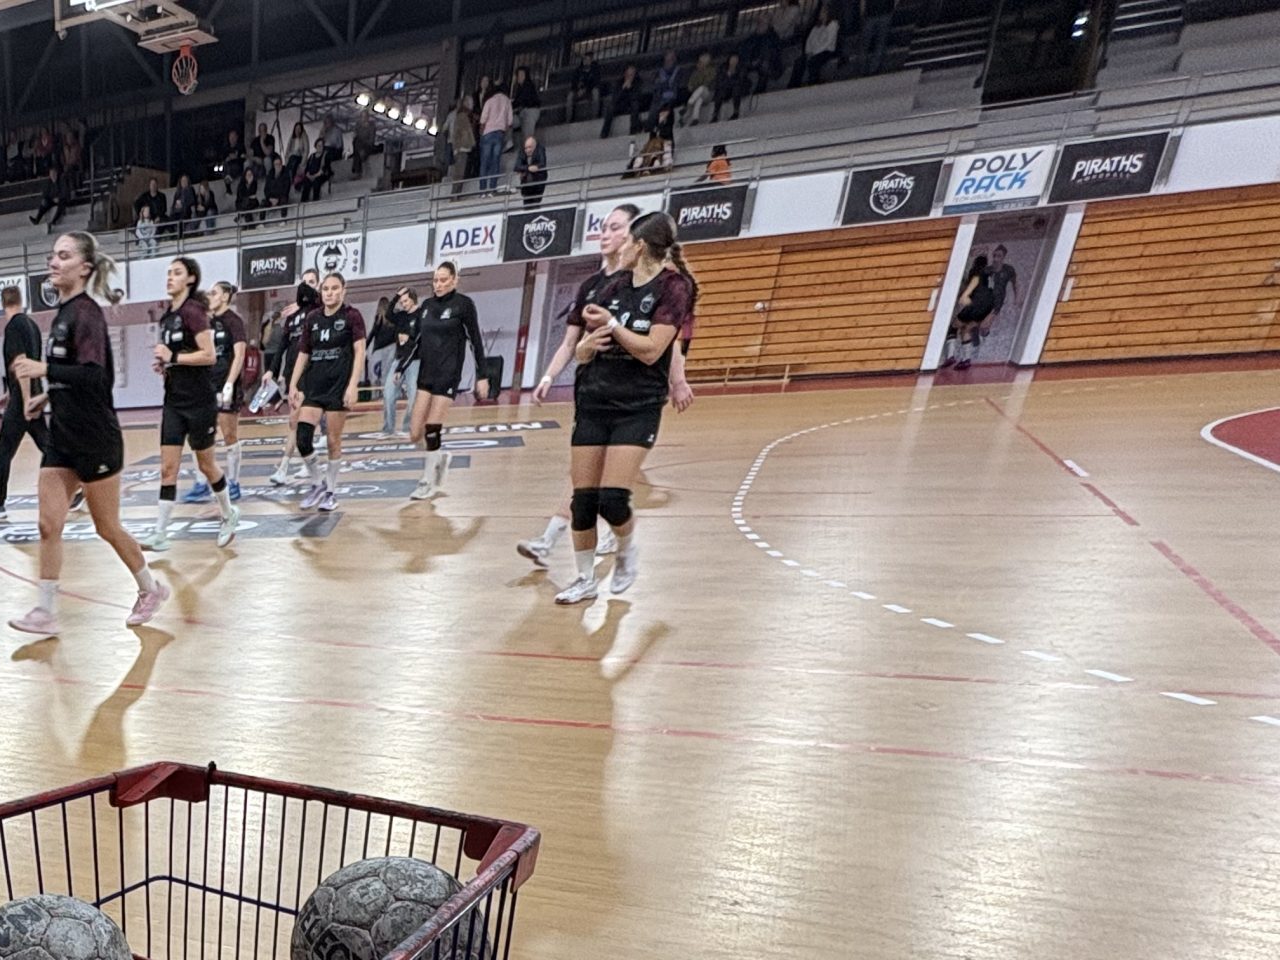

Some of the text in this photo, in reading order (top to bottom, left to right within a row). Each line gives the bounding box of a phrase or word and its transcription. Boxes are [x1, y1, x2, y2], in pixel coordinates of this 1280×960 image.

[965, 150, 1044, 177] POLY
[1071, 153, 1144, 182] PIRATHS
[871, 175, 916, 193] PIRATHS
[955, 170, 1032, 196] RACK
[678, 202, 732, 226] PIRATHS
[440, 224, 497, 250] ADEX
[250, 256, 287, 274] PIRATHS
